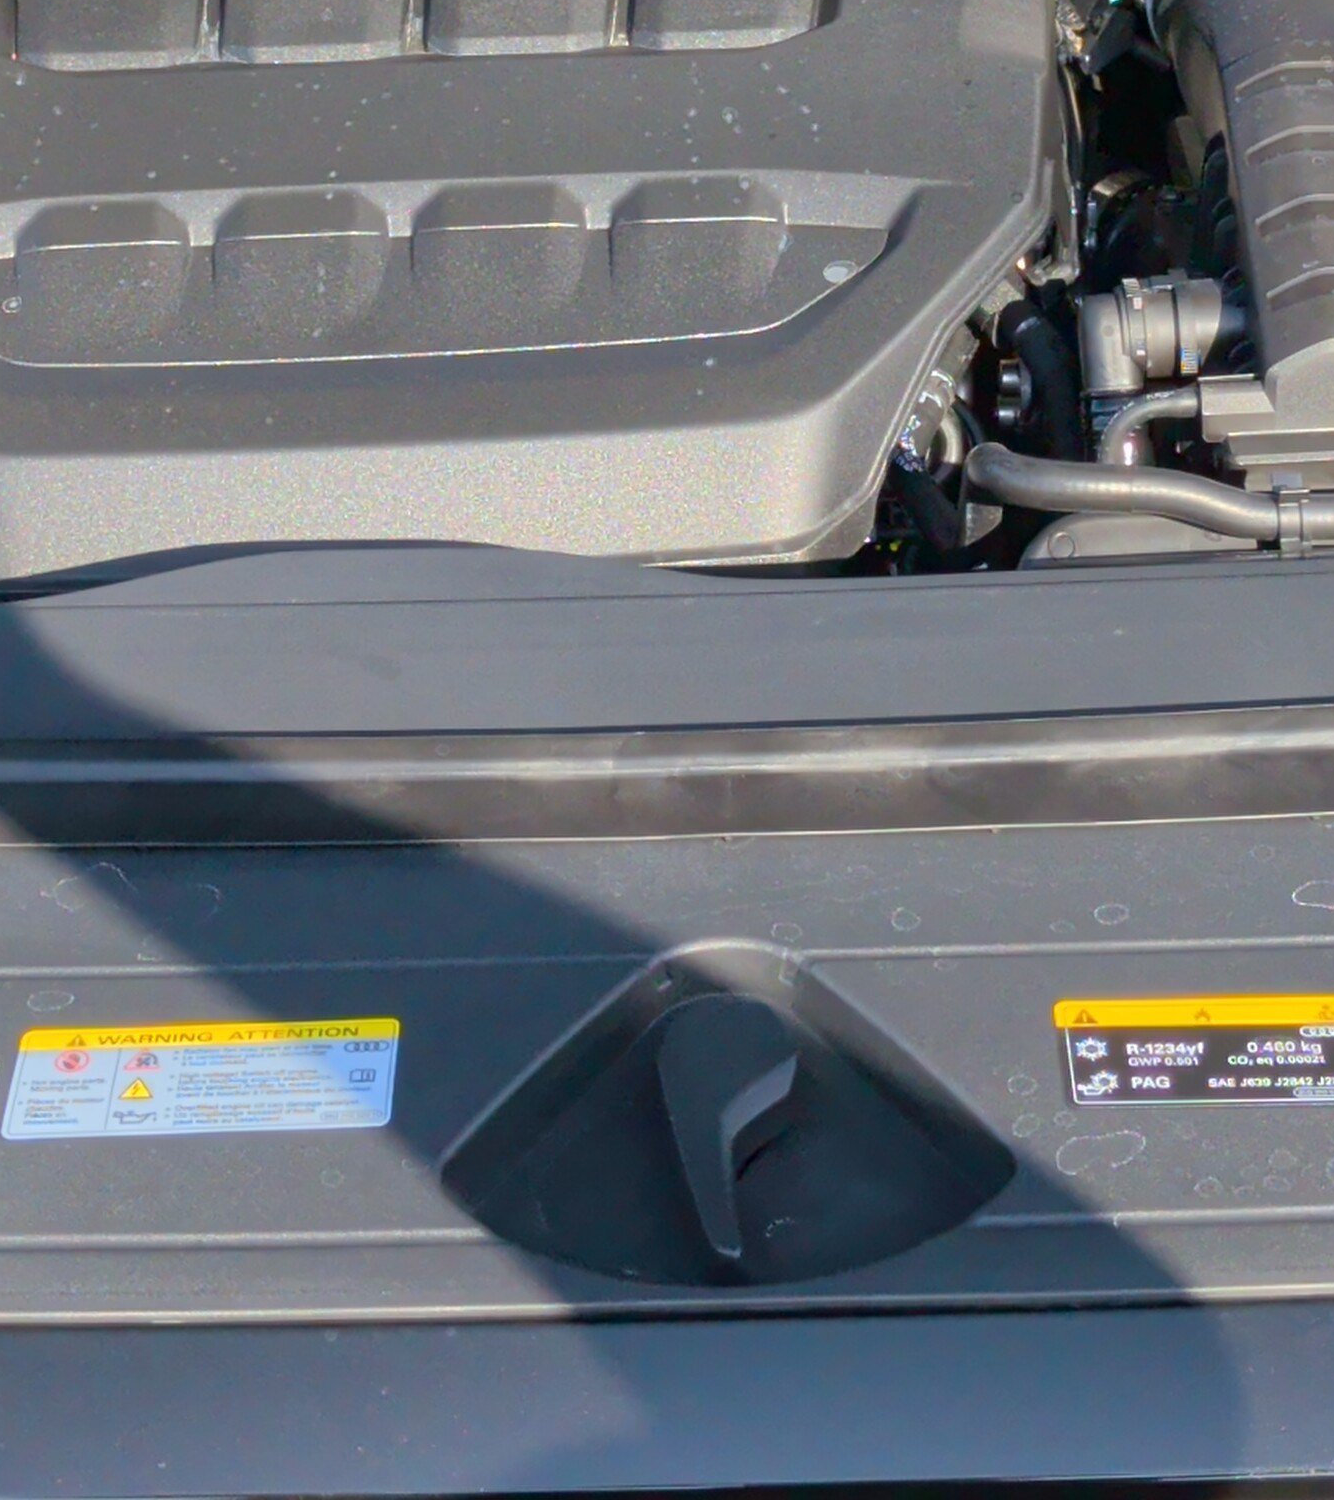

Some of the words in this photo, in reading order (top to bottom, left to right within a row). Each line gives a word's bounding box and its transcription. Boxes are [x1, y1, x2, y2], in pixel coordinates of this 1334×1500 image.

[97, 1031, 214, 1046] WARNING
[229, 1026, 360, 1042] ATTENTION
[1125, 1041, 1205, 1056] R-1234yf
[1301, 1039, 1323, 1055] kg
[1128, 1056, 1162, 1067] GWP
[1131, 1075, 1171, 1090] PAG
